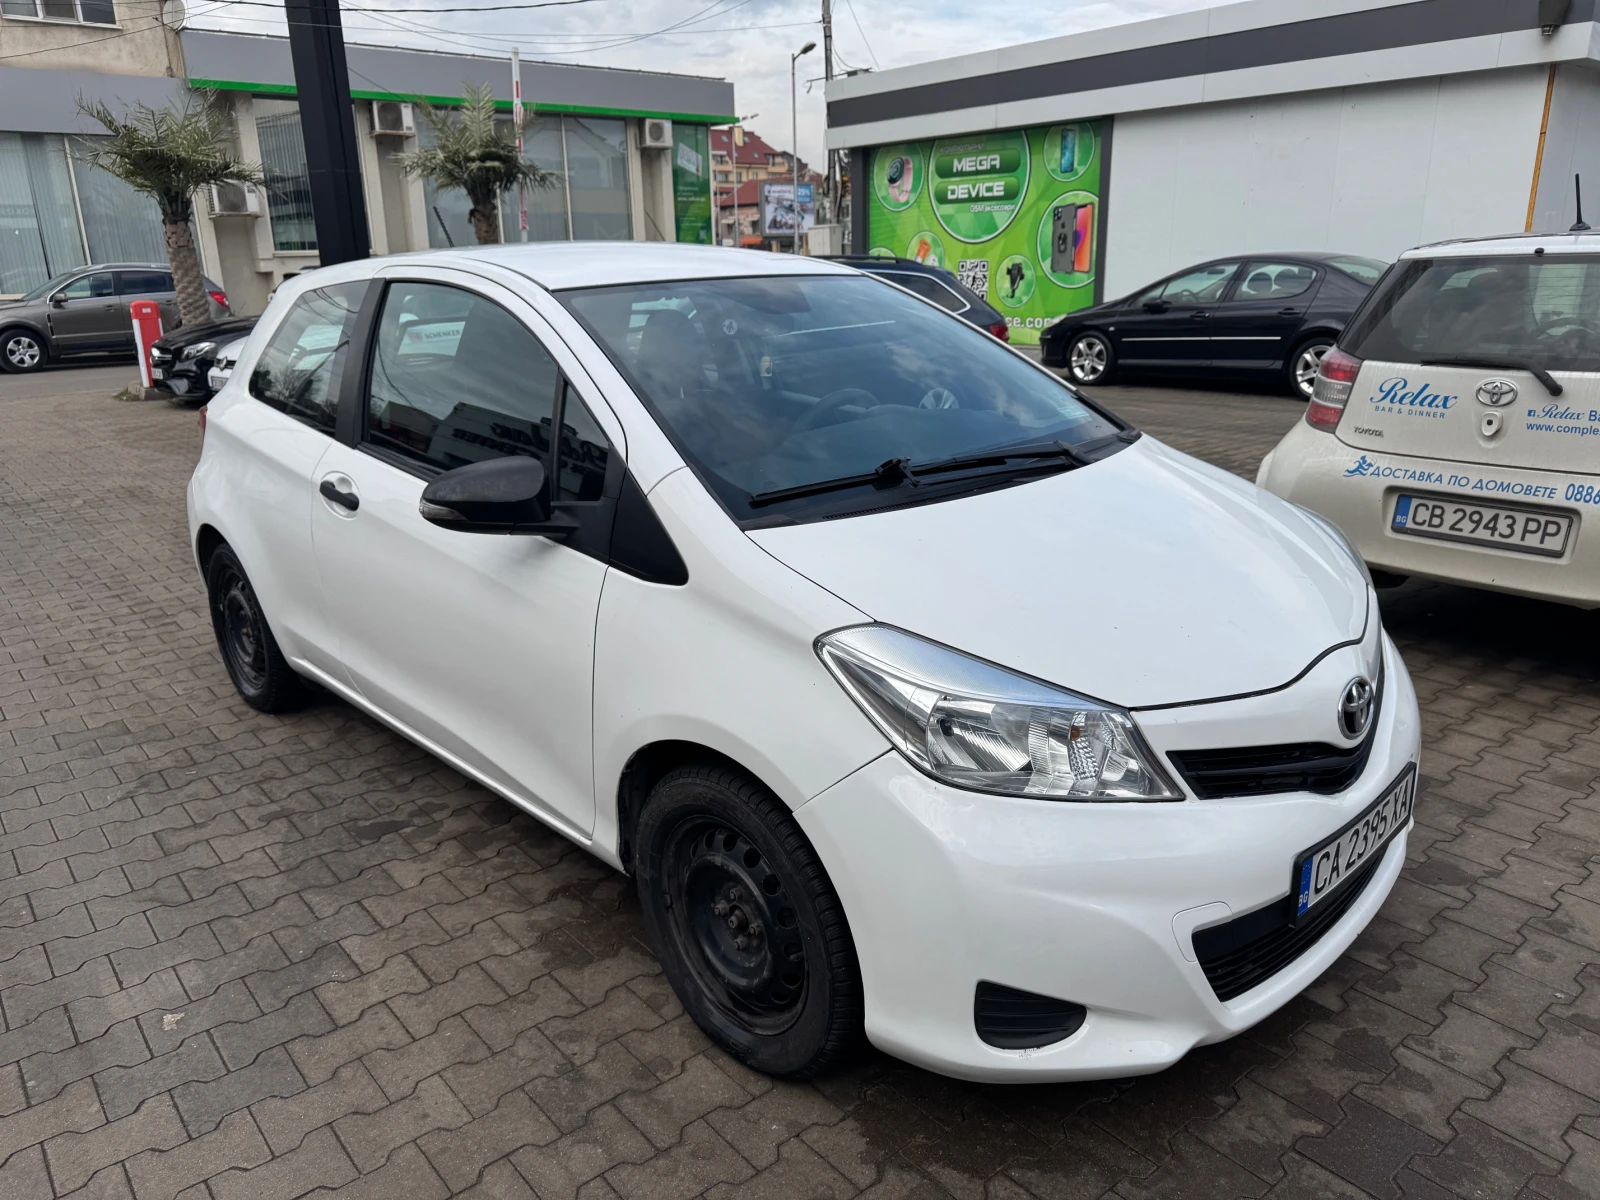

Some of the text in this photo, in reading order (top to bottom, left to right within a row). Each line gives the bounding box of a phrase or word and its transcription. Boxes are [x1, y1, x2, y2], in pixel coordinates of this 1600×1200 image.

[953, 154, 1001, 173] MEGA
[947, 181, 1005, 200] DEVICE
[1370, 377, 1459, 410] Relax
[1374, 405, 1446, 419] BAR & DINNER
[1537, 403, 1586, 421] Relax
[1588, 410, 1600, 422] B
[1354, 425, 1384, 438] TOYOTA
[1526, 422, 1600, 437] www.comple
[1369, 466, 1443, 484] ДОСТАВКА
[1447, 474, 1470, 488] ПО
[1471, 478, 1558, 500] ДОМОВЕТЕ
[1395, 514, 1407, 524] BG
[1411, 503, 1562, 545] CB 2943 PP
[1314, 779, 1409, 895] CA 2395 XA
[1298, 890, 1309, 907] BG
